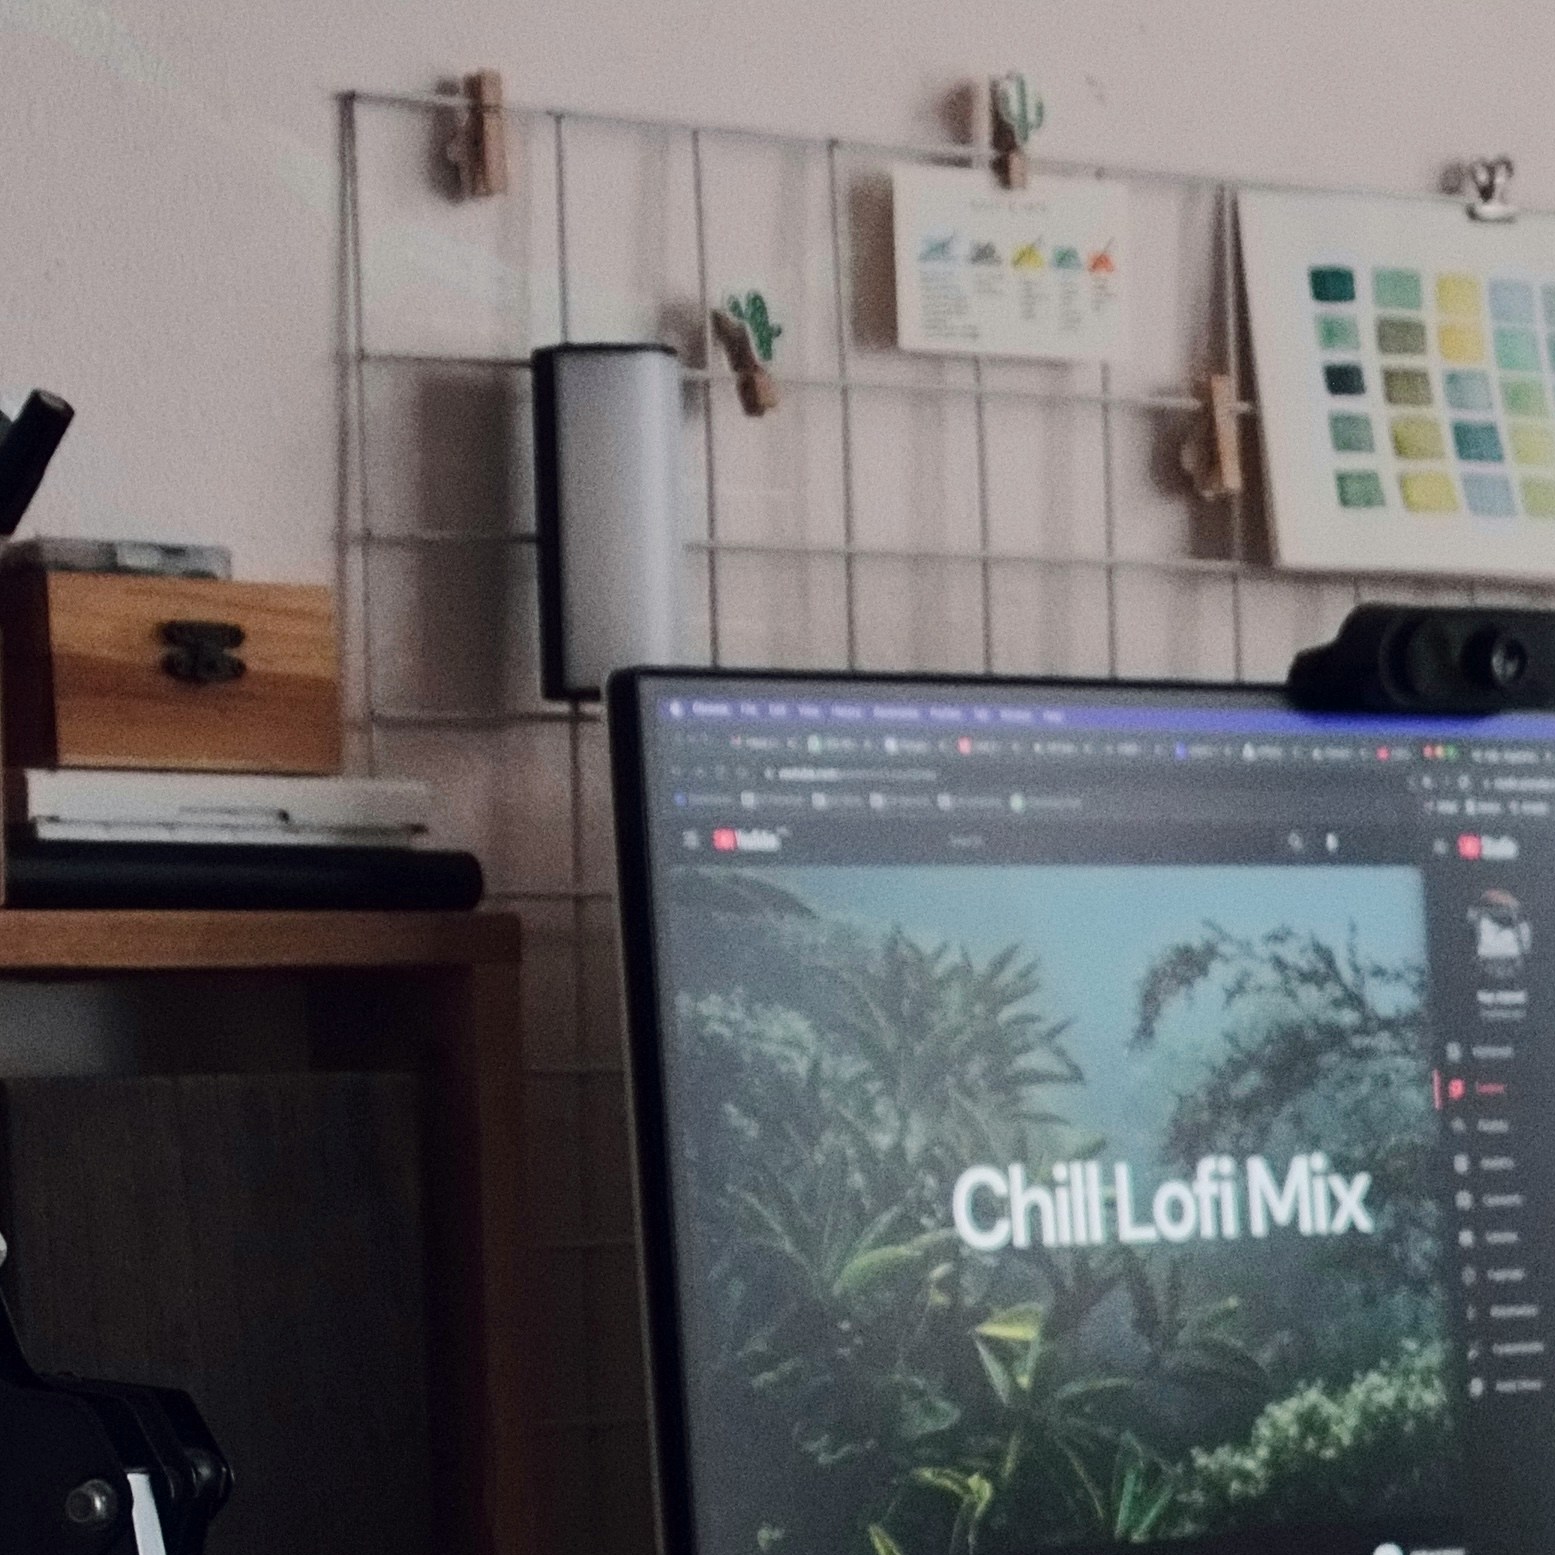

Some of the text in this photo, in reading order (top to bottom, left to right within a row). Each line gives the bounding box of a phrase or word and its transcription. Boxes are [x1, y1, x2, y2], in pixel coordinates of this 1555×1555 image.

[952, 1152, 1375, 1251] Chill Lofi Mix
